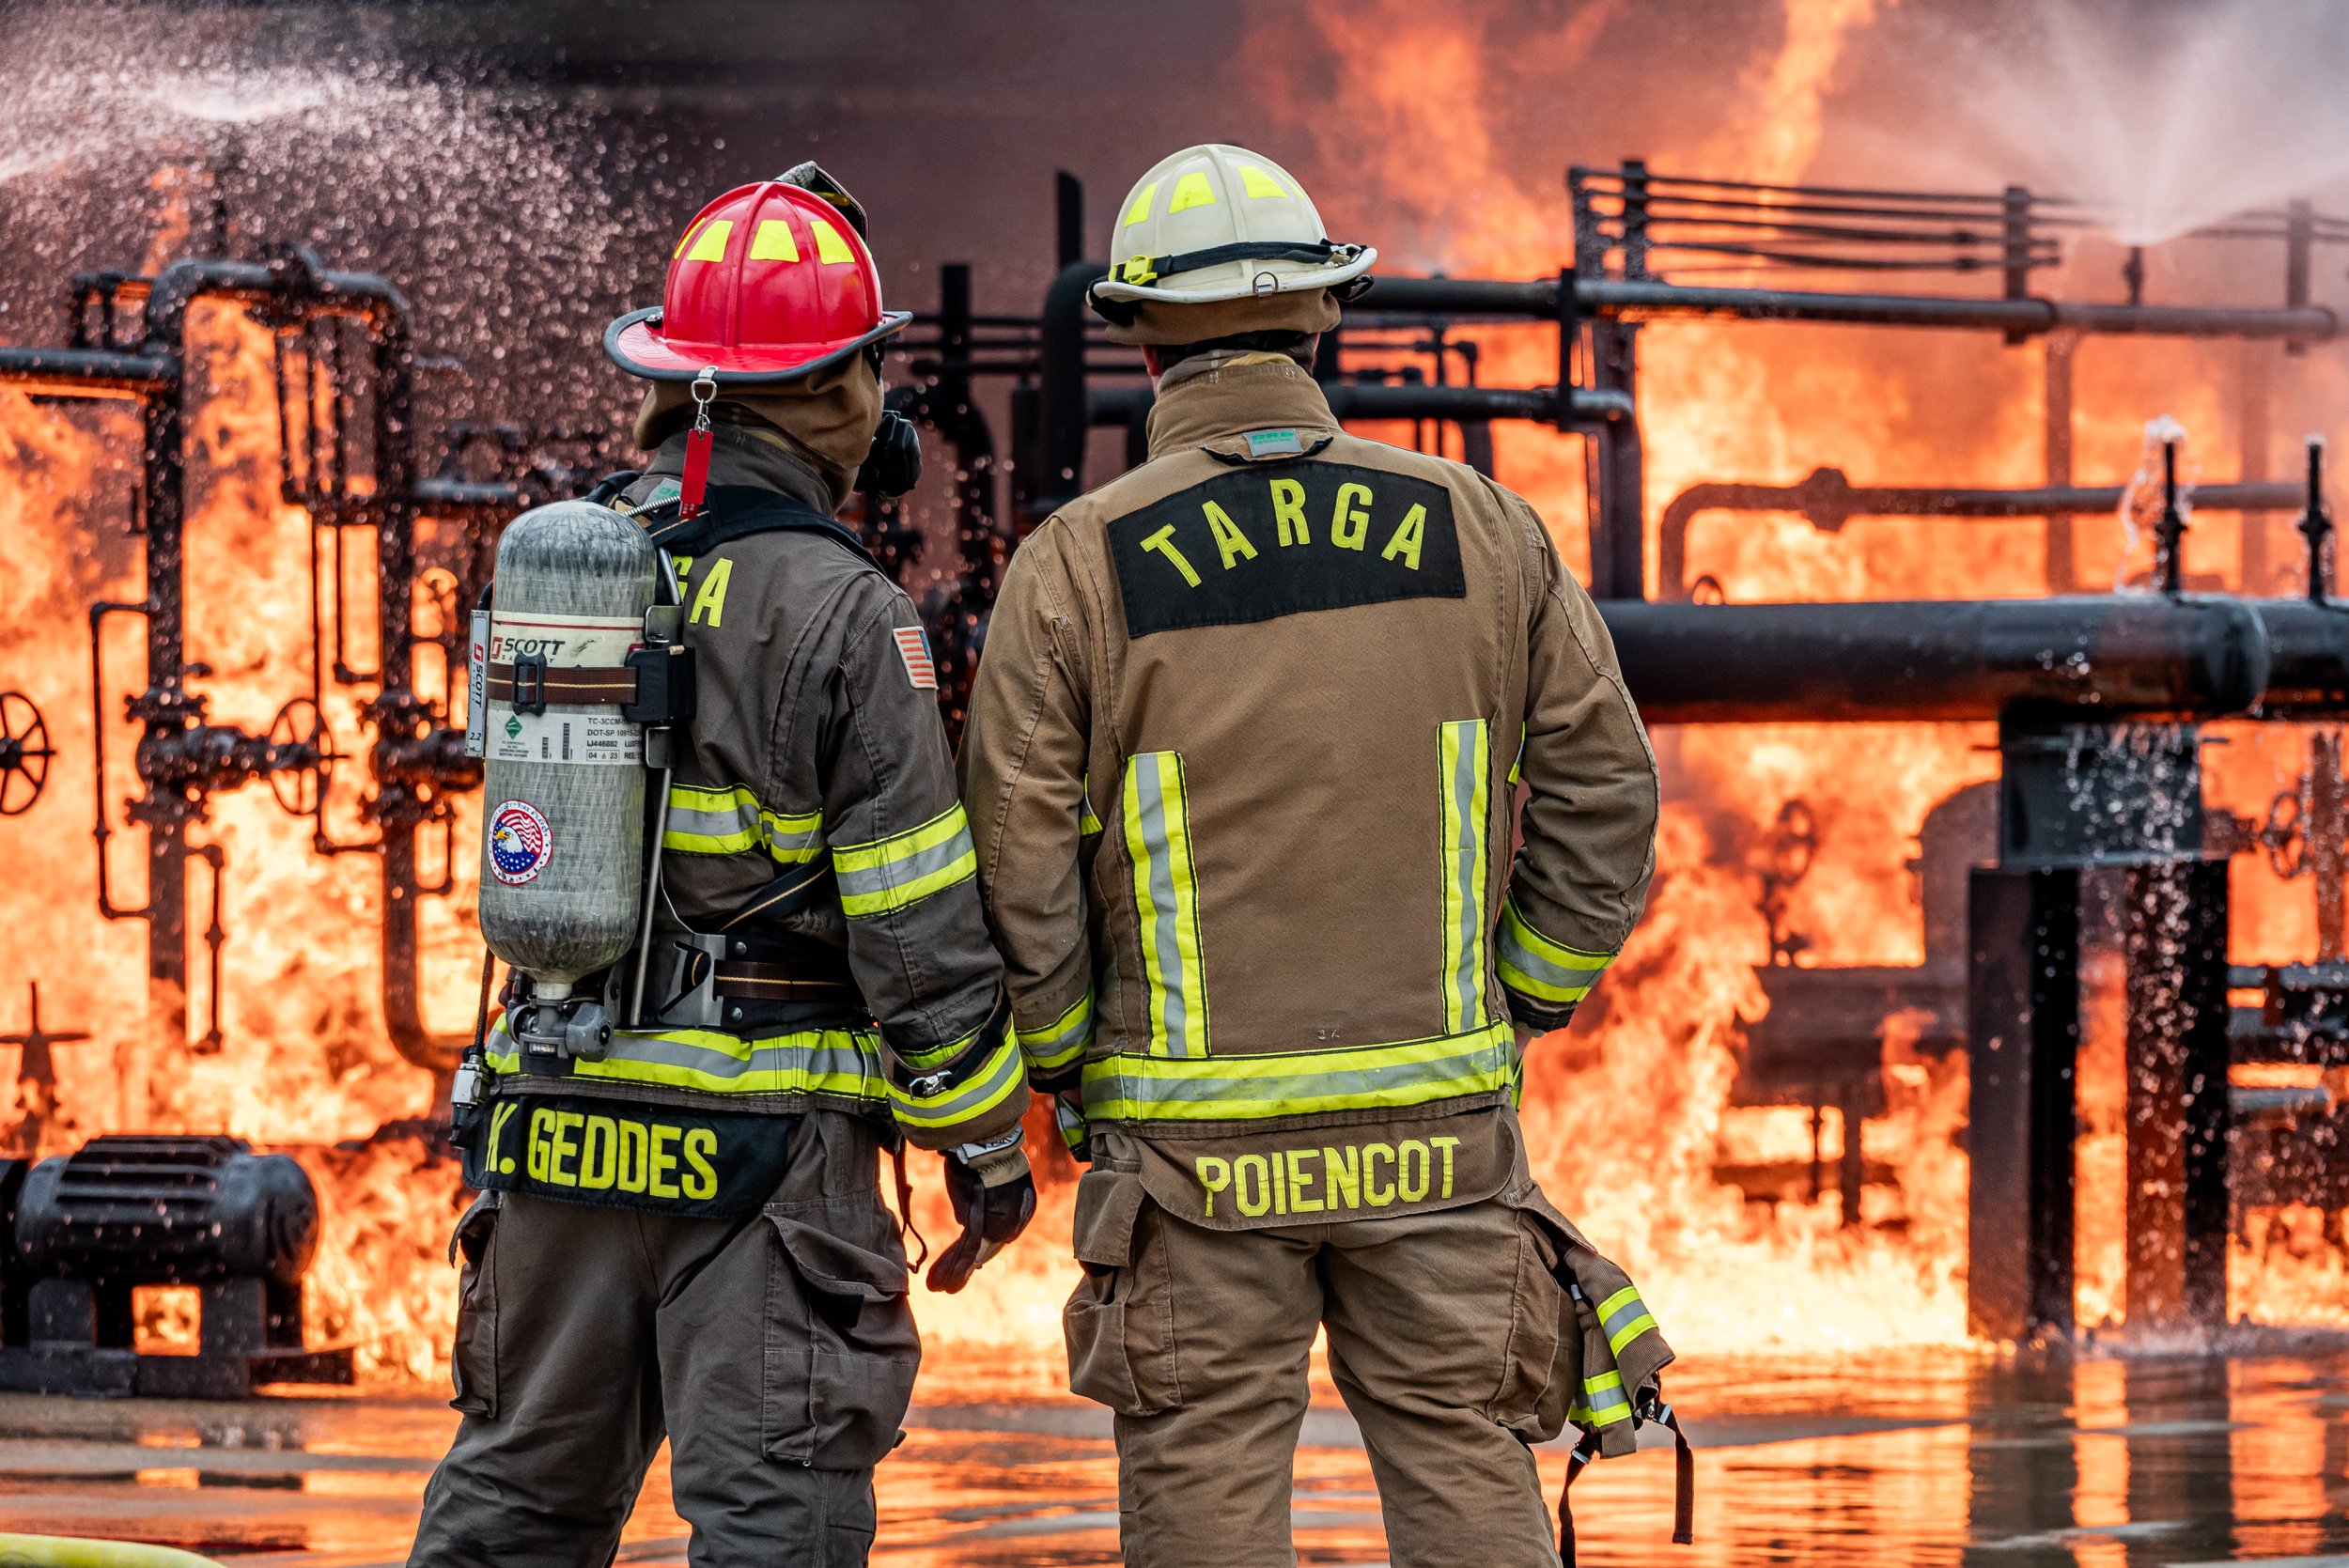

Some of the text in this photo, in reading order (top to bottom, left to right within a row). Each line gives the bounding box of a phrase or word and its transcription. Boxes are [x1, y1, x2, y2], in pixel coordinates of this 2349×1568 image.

[1140, 478, 1427, 588] TARGA
[502, 655, 555, 663] SAY
[504, 638, 566, 656] SCOTT
[474, 663, 484, 708] SCOTT
[527, 1108, 718, 1201] GEDDES
[1195, 1137, 1461, 1218] POIENCOT
